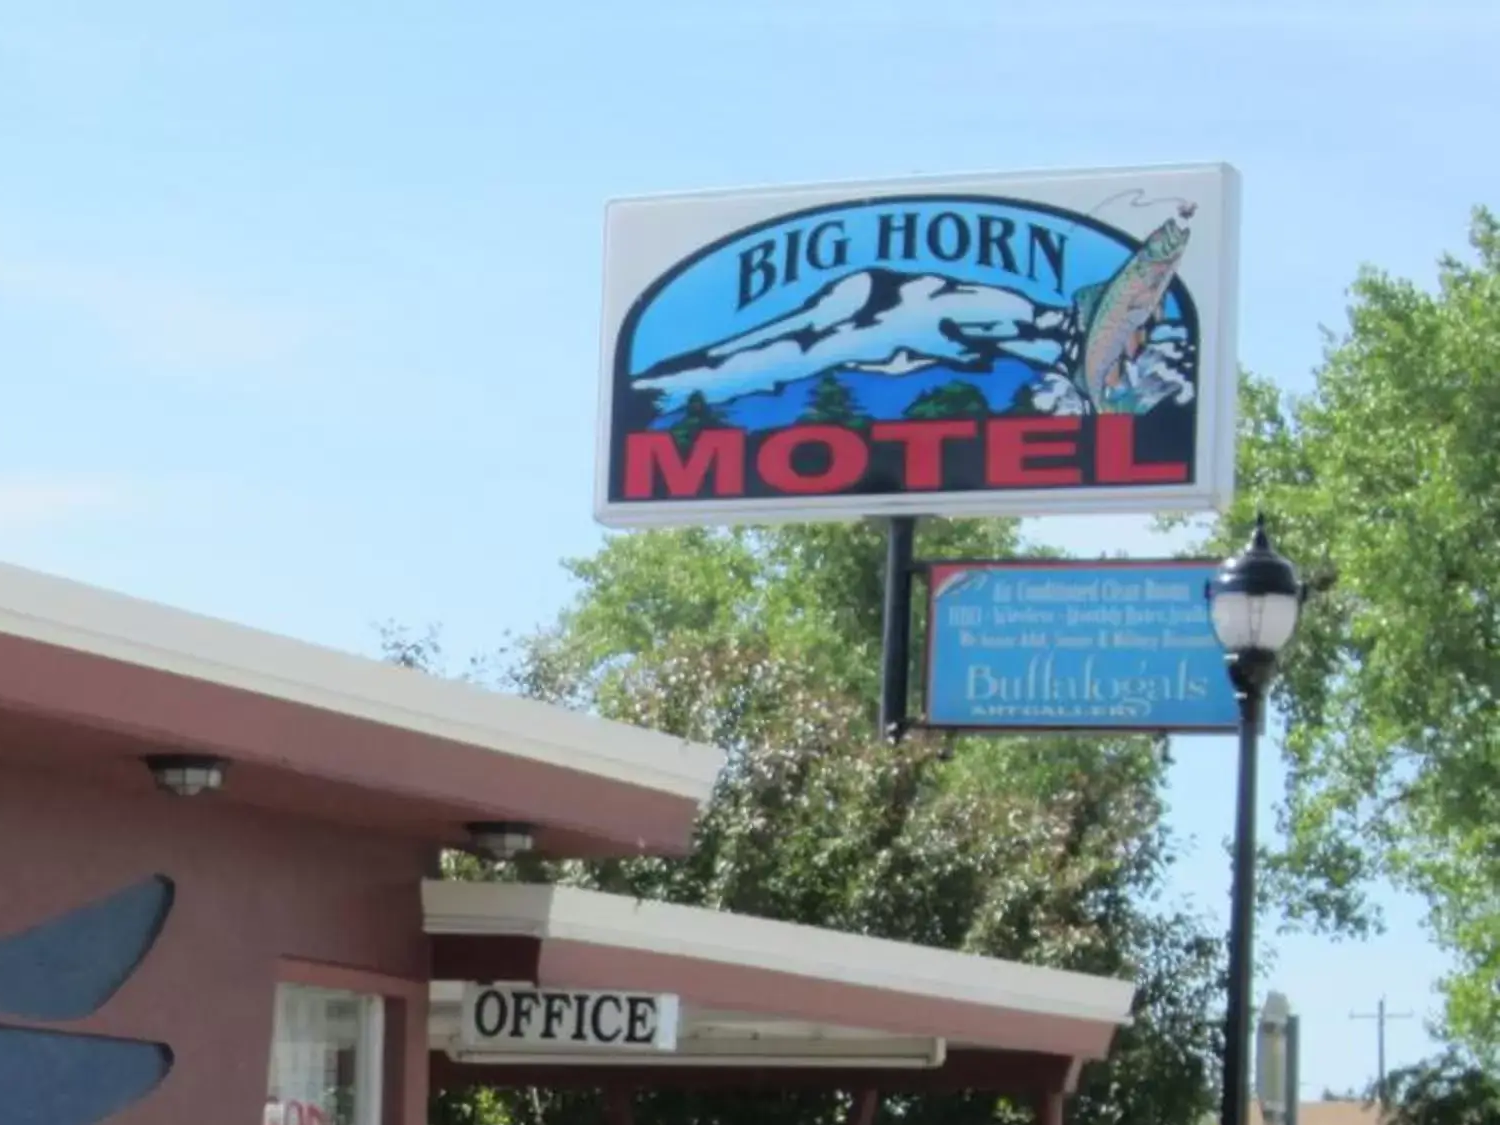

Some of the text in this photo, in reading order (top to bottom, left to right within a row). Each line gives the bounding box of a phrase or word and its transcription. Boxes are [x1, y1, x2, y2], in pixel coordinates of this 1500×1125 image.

[736, 211, 1070, 312] BIG HORN
[623, 413, 1189, 499] MOTEL
[474, 989, 657, 1043] OFFICE
